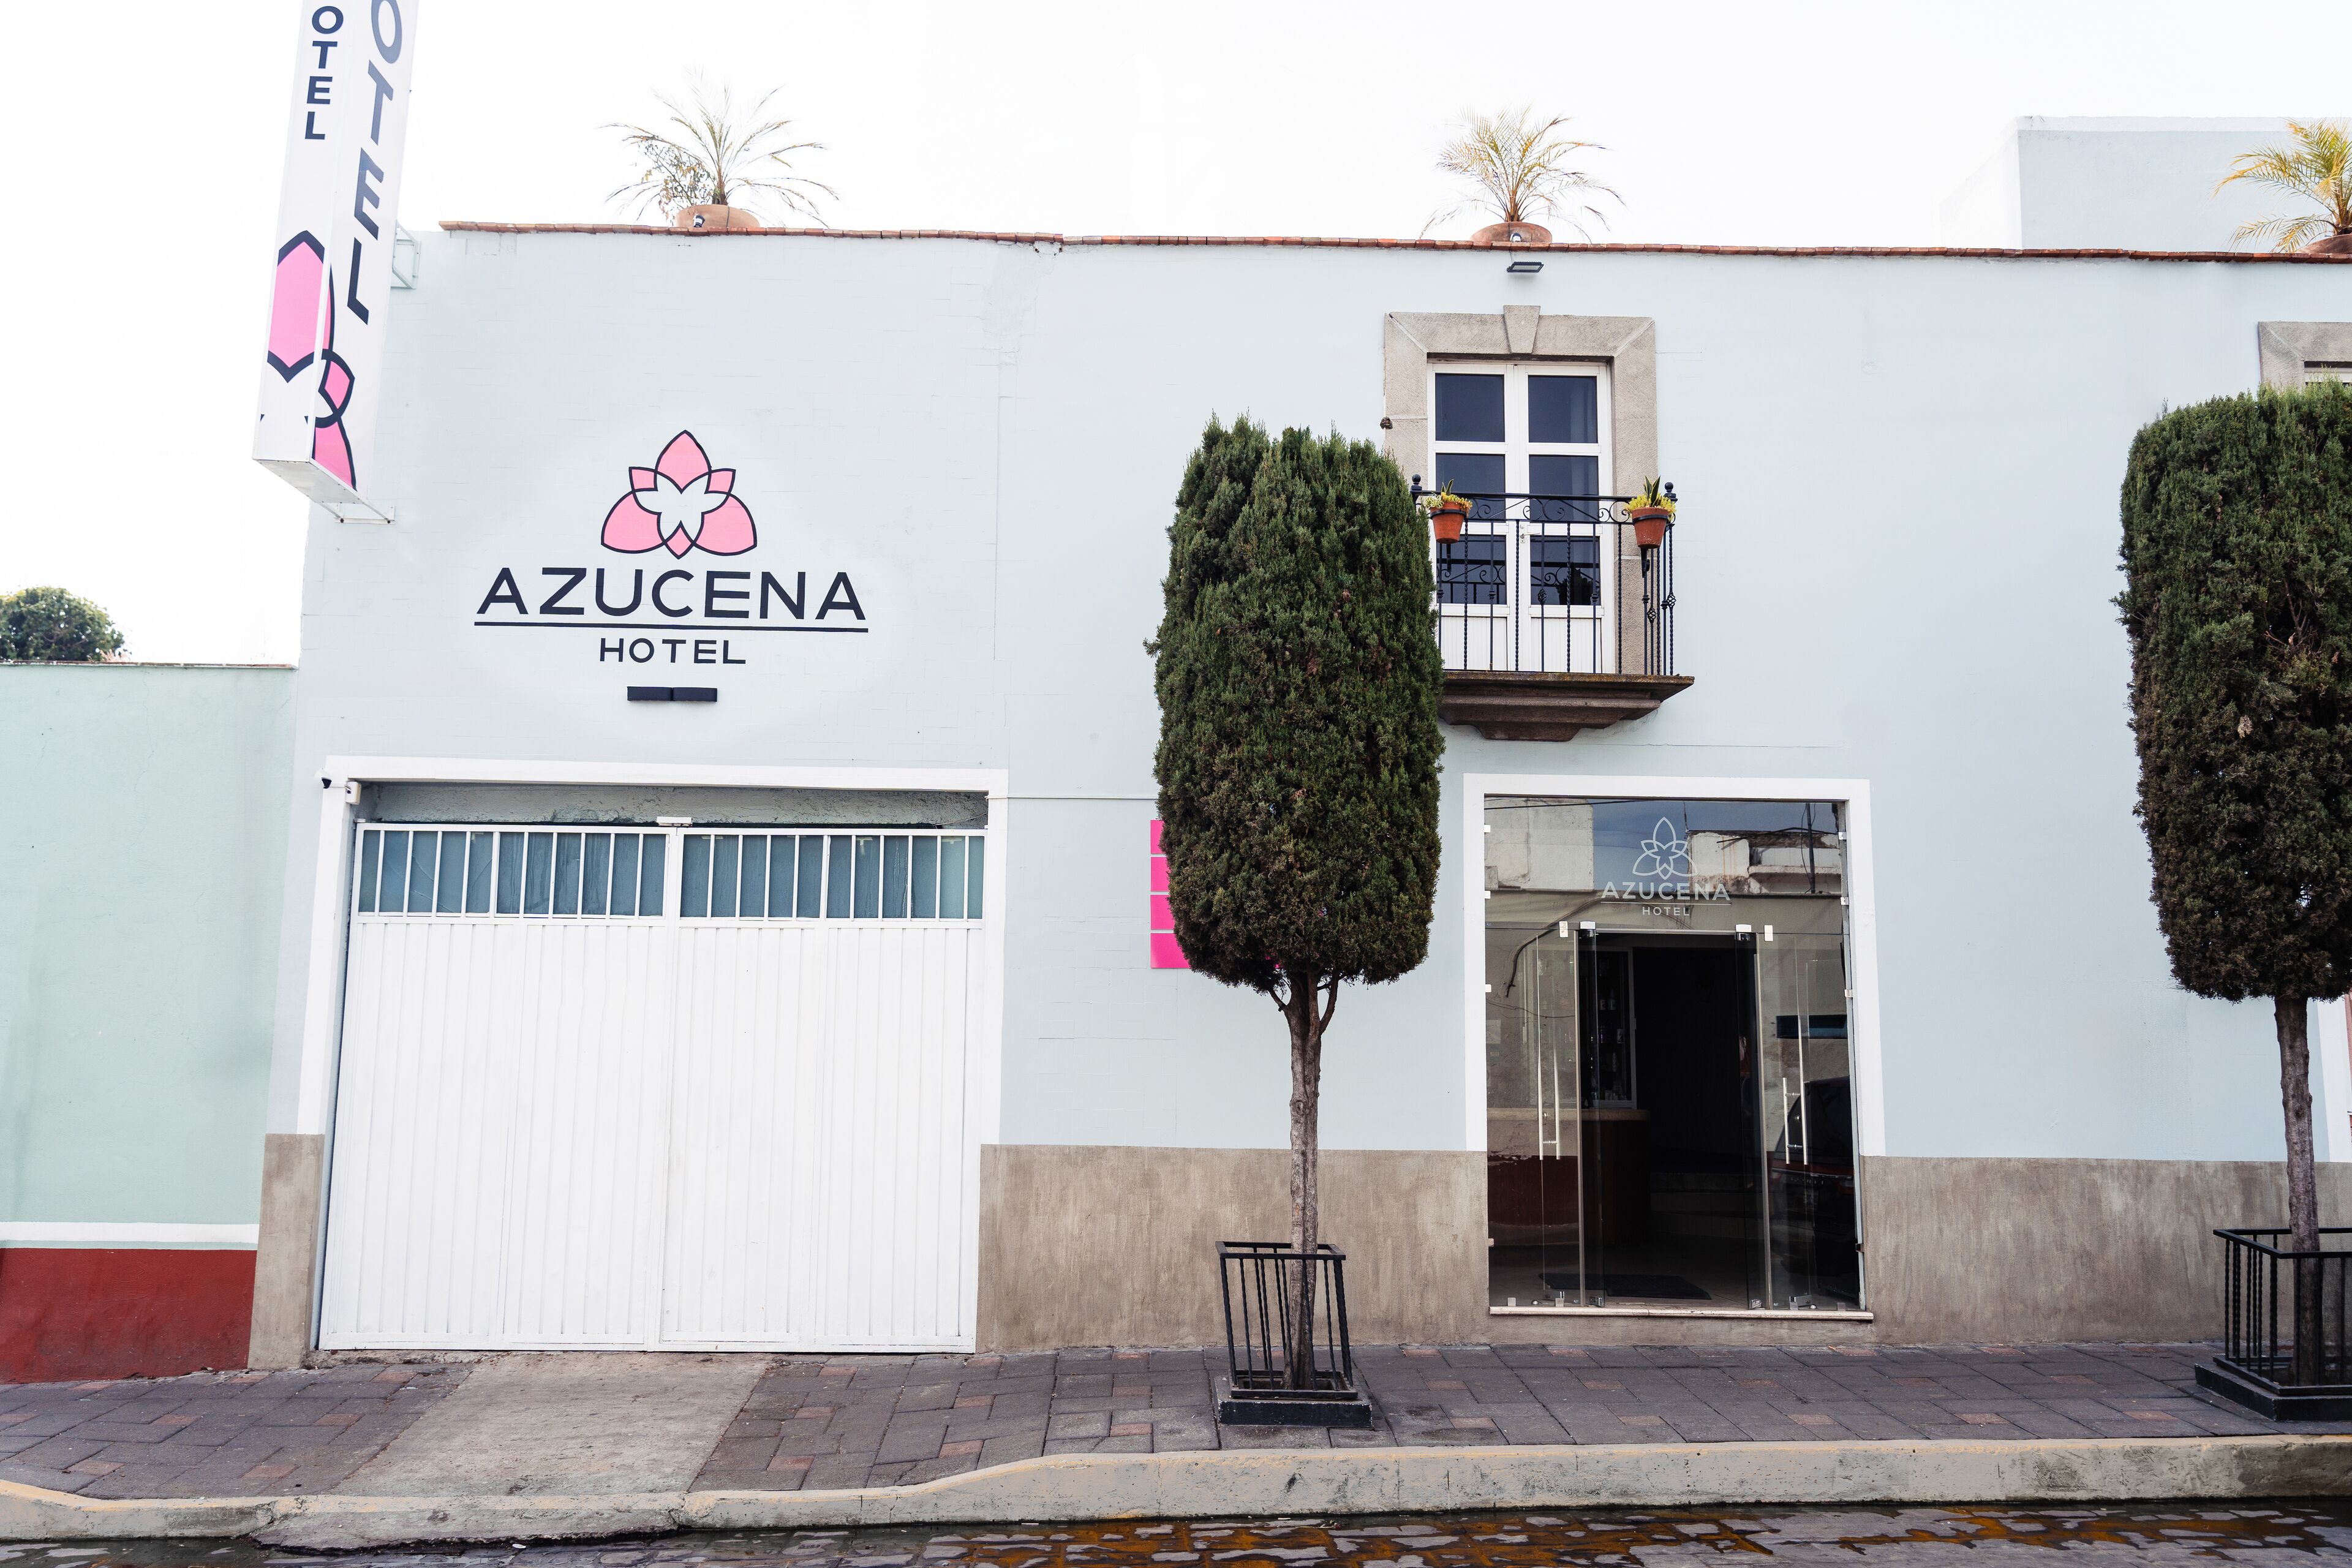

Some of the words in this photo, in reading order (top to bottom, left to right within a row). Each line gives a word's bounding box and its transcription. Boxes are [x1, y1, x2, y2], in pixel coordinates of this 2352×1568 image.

[305, 6, 344, 140] OTEL
[347, 0, 402, 326] OTEL
[477, 567, 866, 620] AZUCENA
[600, 638, 746, 664] HOTEL
[1600, 881, 1731, 901] AZUCENA
[1642, 907, 1690, 916] HOTEL
